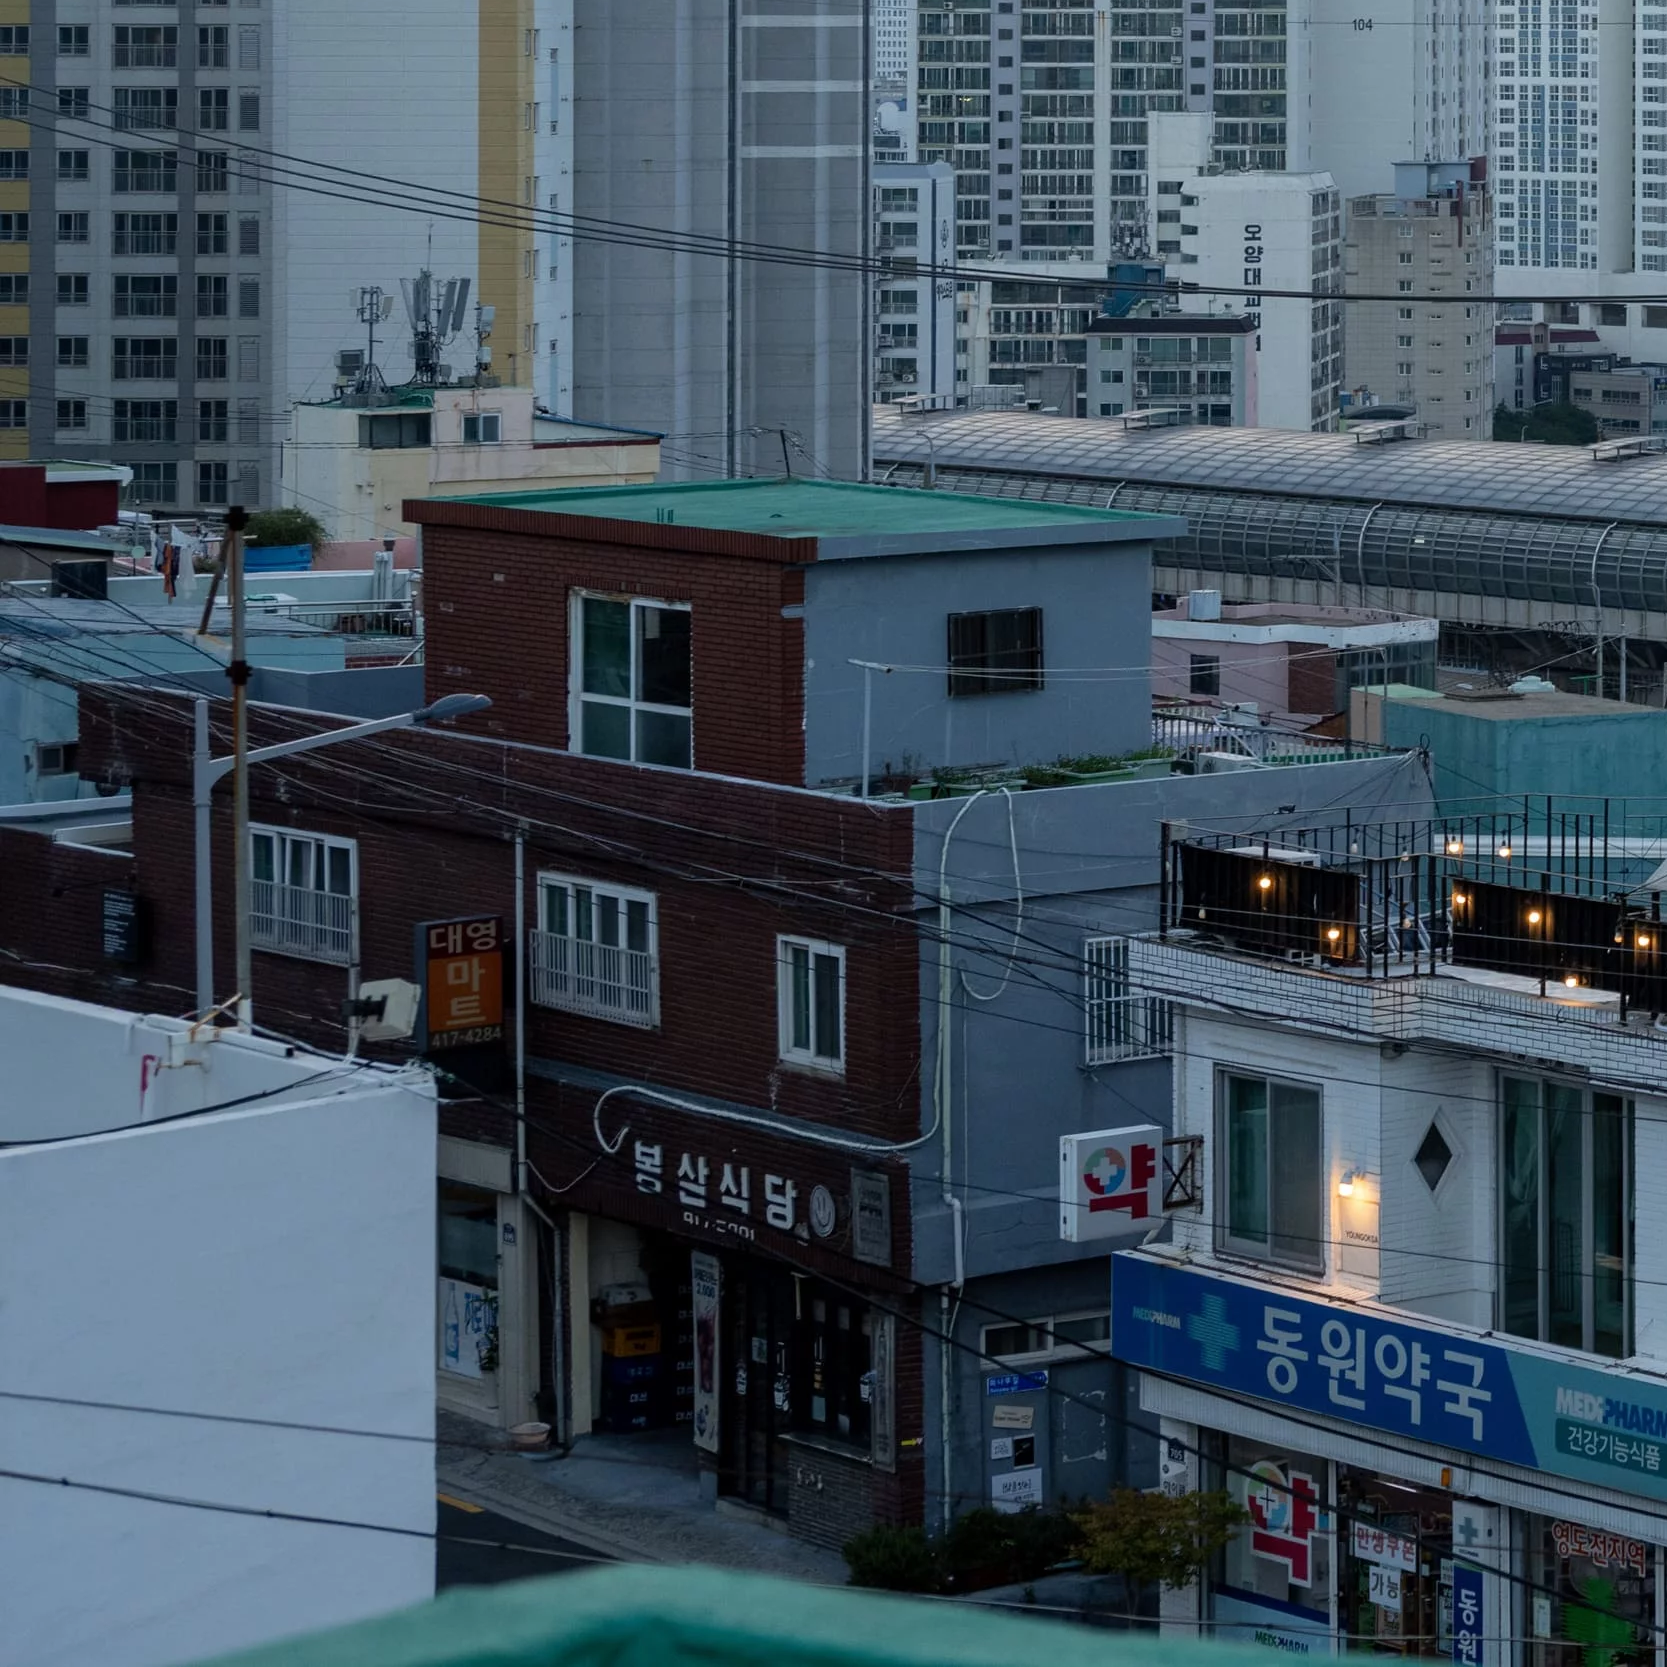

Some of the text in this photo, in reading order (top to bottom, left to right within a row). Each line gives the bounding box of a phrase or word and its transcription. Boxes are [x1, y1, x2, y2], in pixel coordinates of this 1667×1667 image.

[1352, 18, 1373, 32] 104
[429, 919, 498, 955] 대영
[445, 957, 487, 1026] 마트
[431, 1026, 503, 1049] 417-4284
[633, 1138, 800, 1232] 봉산식당
[1083, 1144, 1155, 1220] 약
[1132, 1306, 1181, 1331] MEDIPHARM
[1255, 1305, 1492, 1442] 동원약국
[1566, 1424, 1661, 1472] 건강기능식품
[1247, 1462, 1320, 1586] 약
[1356, 1526, 1416, 1563] 민생쿠폰
[1552, 1521, 1646, 1579] 영도전지역
[1371, 1572, 1399, 1601] 가능
